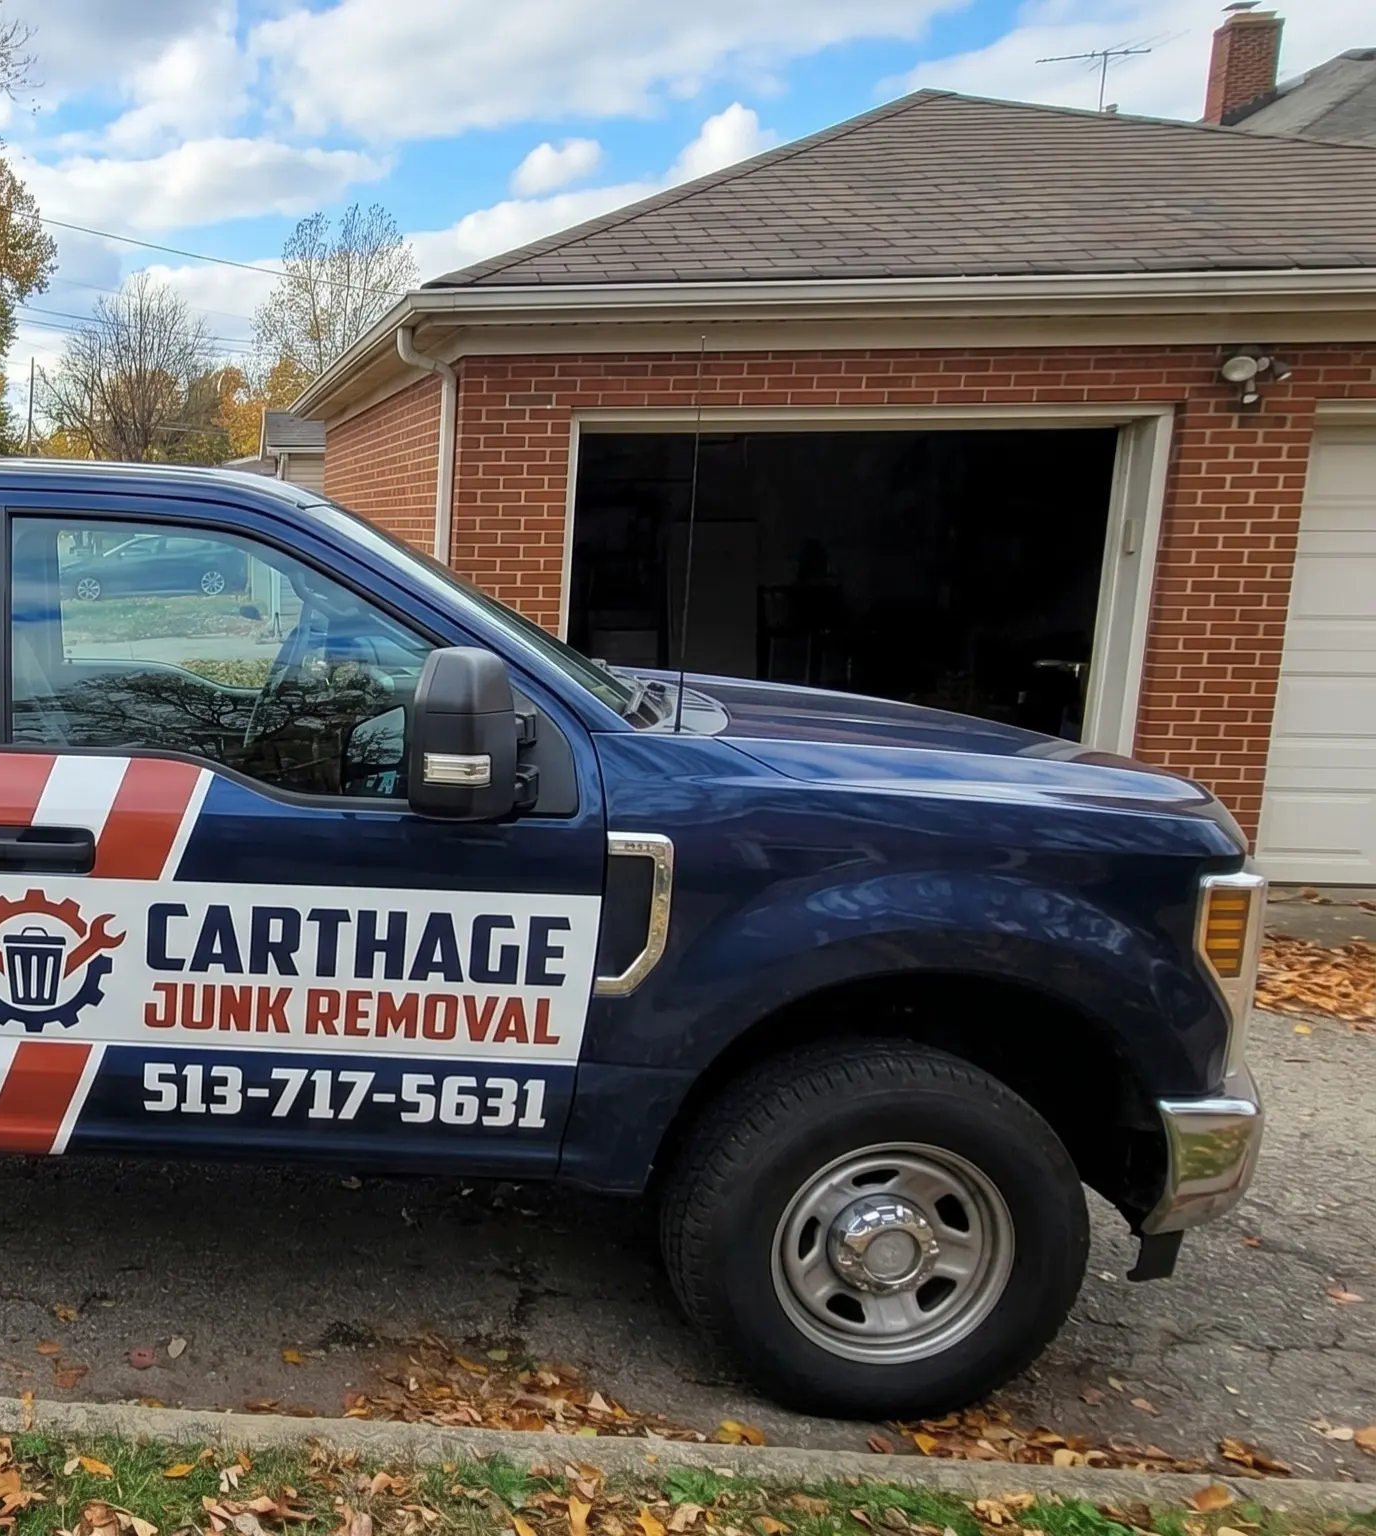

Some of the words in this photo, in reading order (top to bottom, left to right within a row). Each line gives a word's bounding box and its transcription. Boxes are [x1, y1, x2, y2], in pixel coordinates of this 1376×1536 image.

[146, 902, 572, 987] CARTHAGE
[143, 982, 290, 1034] JUNK
[305, 988, 560, 1045] REMOVAL
[143, 1062, 546, 1129] 513-717-5631
